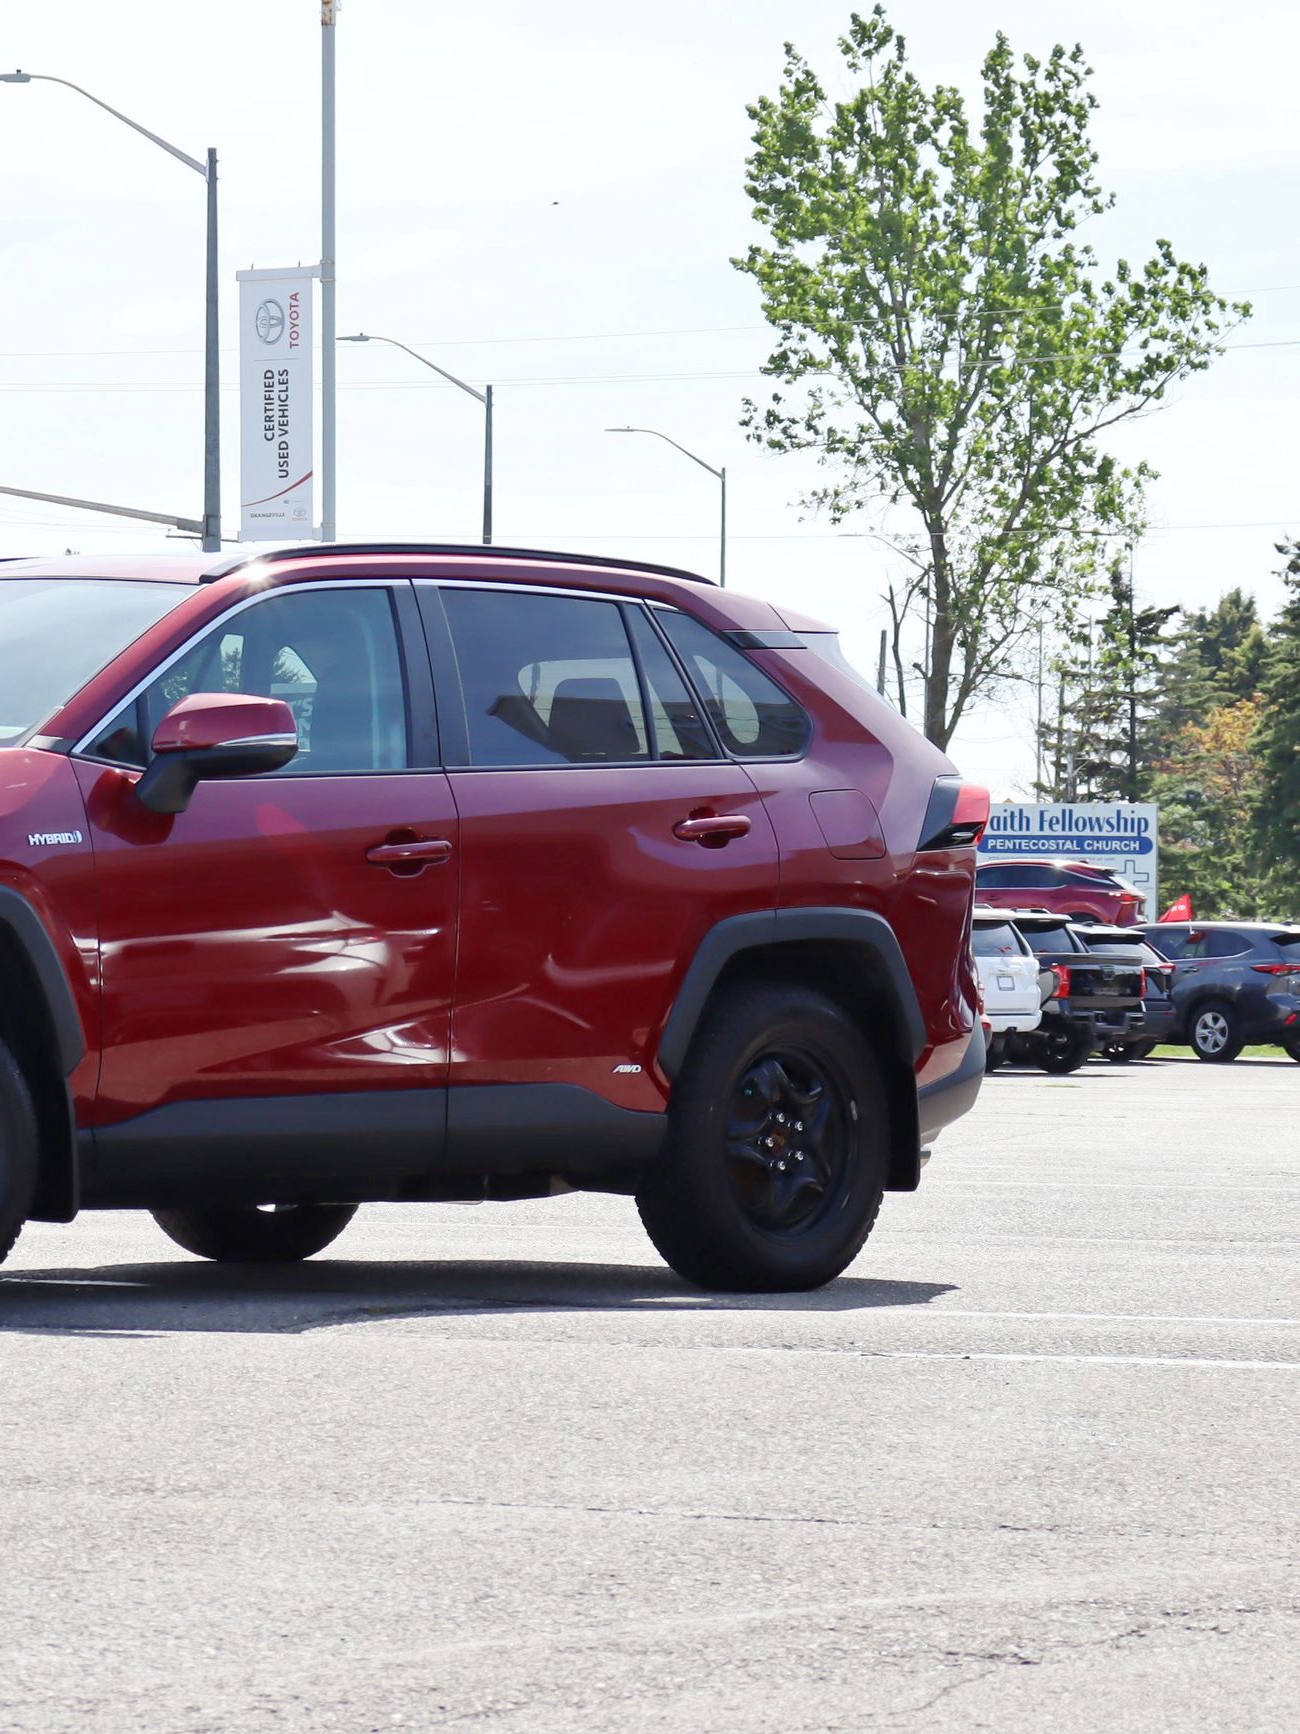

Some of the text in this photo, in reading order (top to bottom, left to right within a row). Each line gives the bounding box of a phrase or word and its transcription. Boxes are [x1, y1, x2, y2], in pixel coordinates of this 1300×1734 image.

[289, 291, 300, 350] TOYOTA
[263, 369, 275, 442] CERTIFIED
[278, 368, 289, 479] USED VEHICLES
[989, 808, 1149, 837] aith Fellowship
[27, 832, 77, 846] HYBRID
[987, 839, 1140, 852] PENTECOSTAL CHURCH
[612, 1064, 642, 1073] AWD
